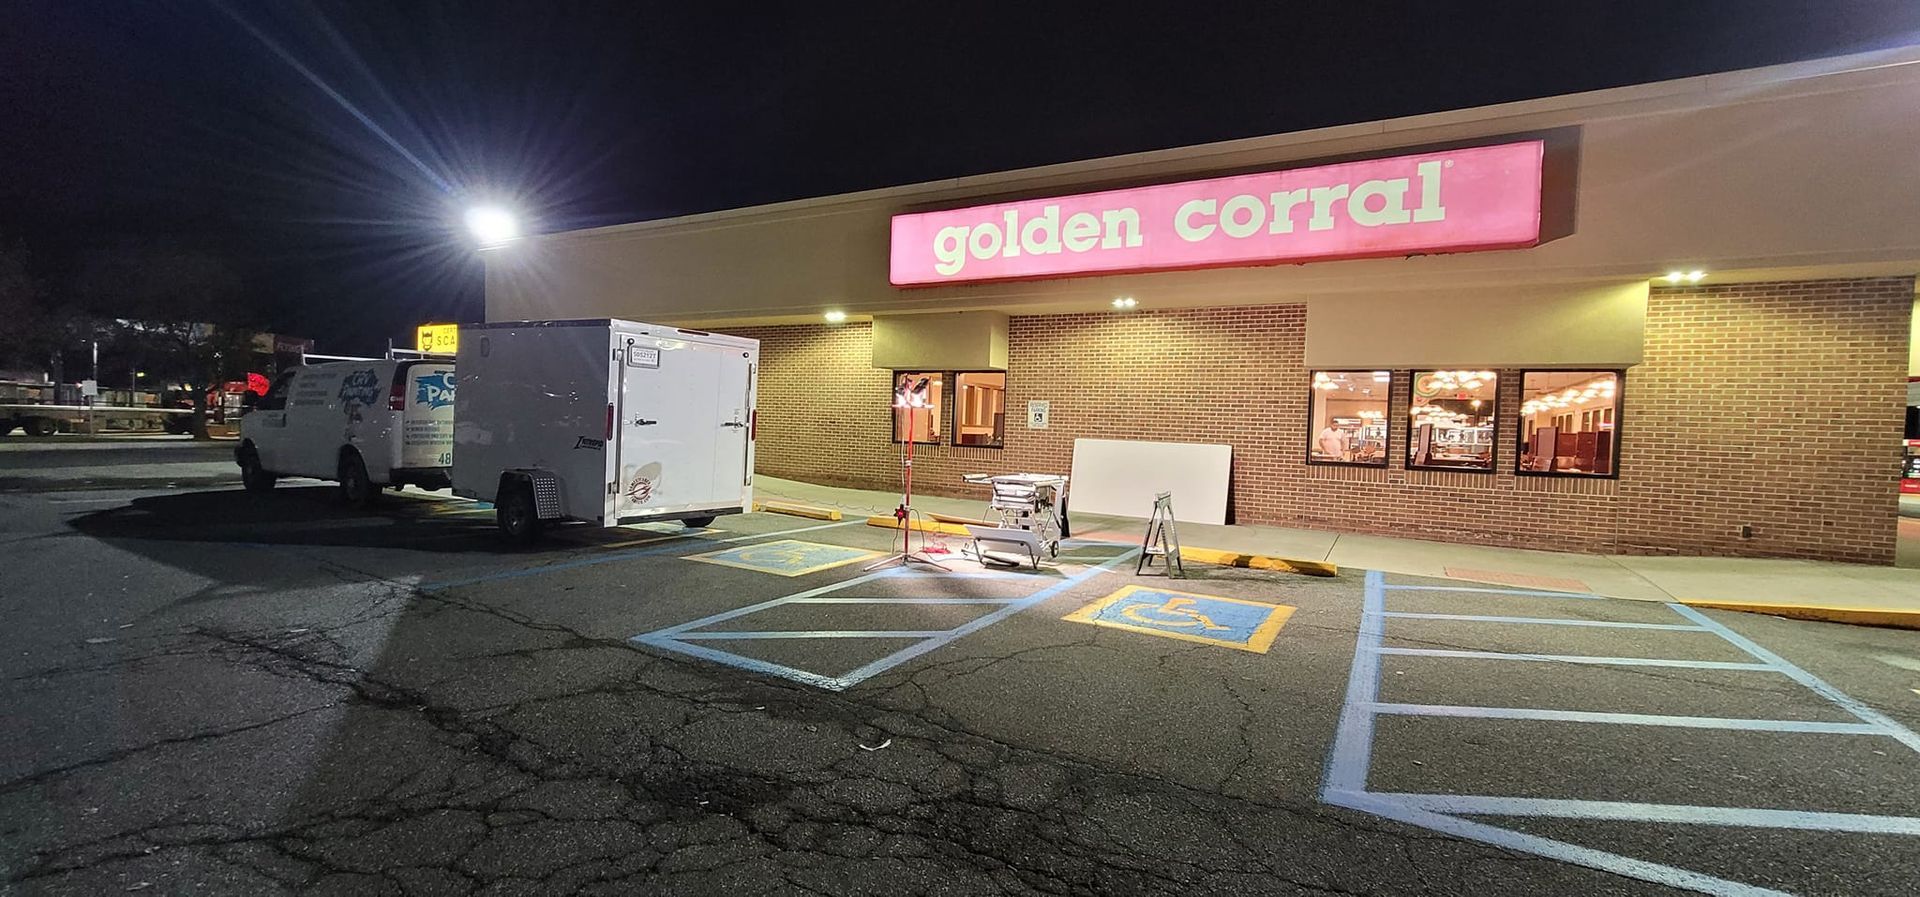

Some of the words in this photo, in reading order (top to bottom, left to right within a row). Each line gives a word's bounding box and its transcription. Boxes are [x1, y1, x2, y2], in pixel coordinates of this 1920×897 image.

[934, 206, 1143, 275] golden
[1173, 160, 1446, 242] corral
[436, 335, 455, 346] SCA
[438, 453, 451, 465] 48
